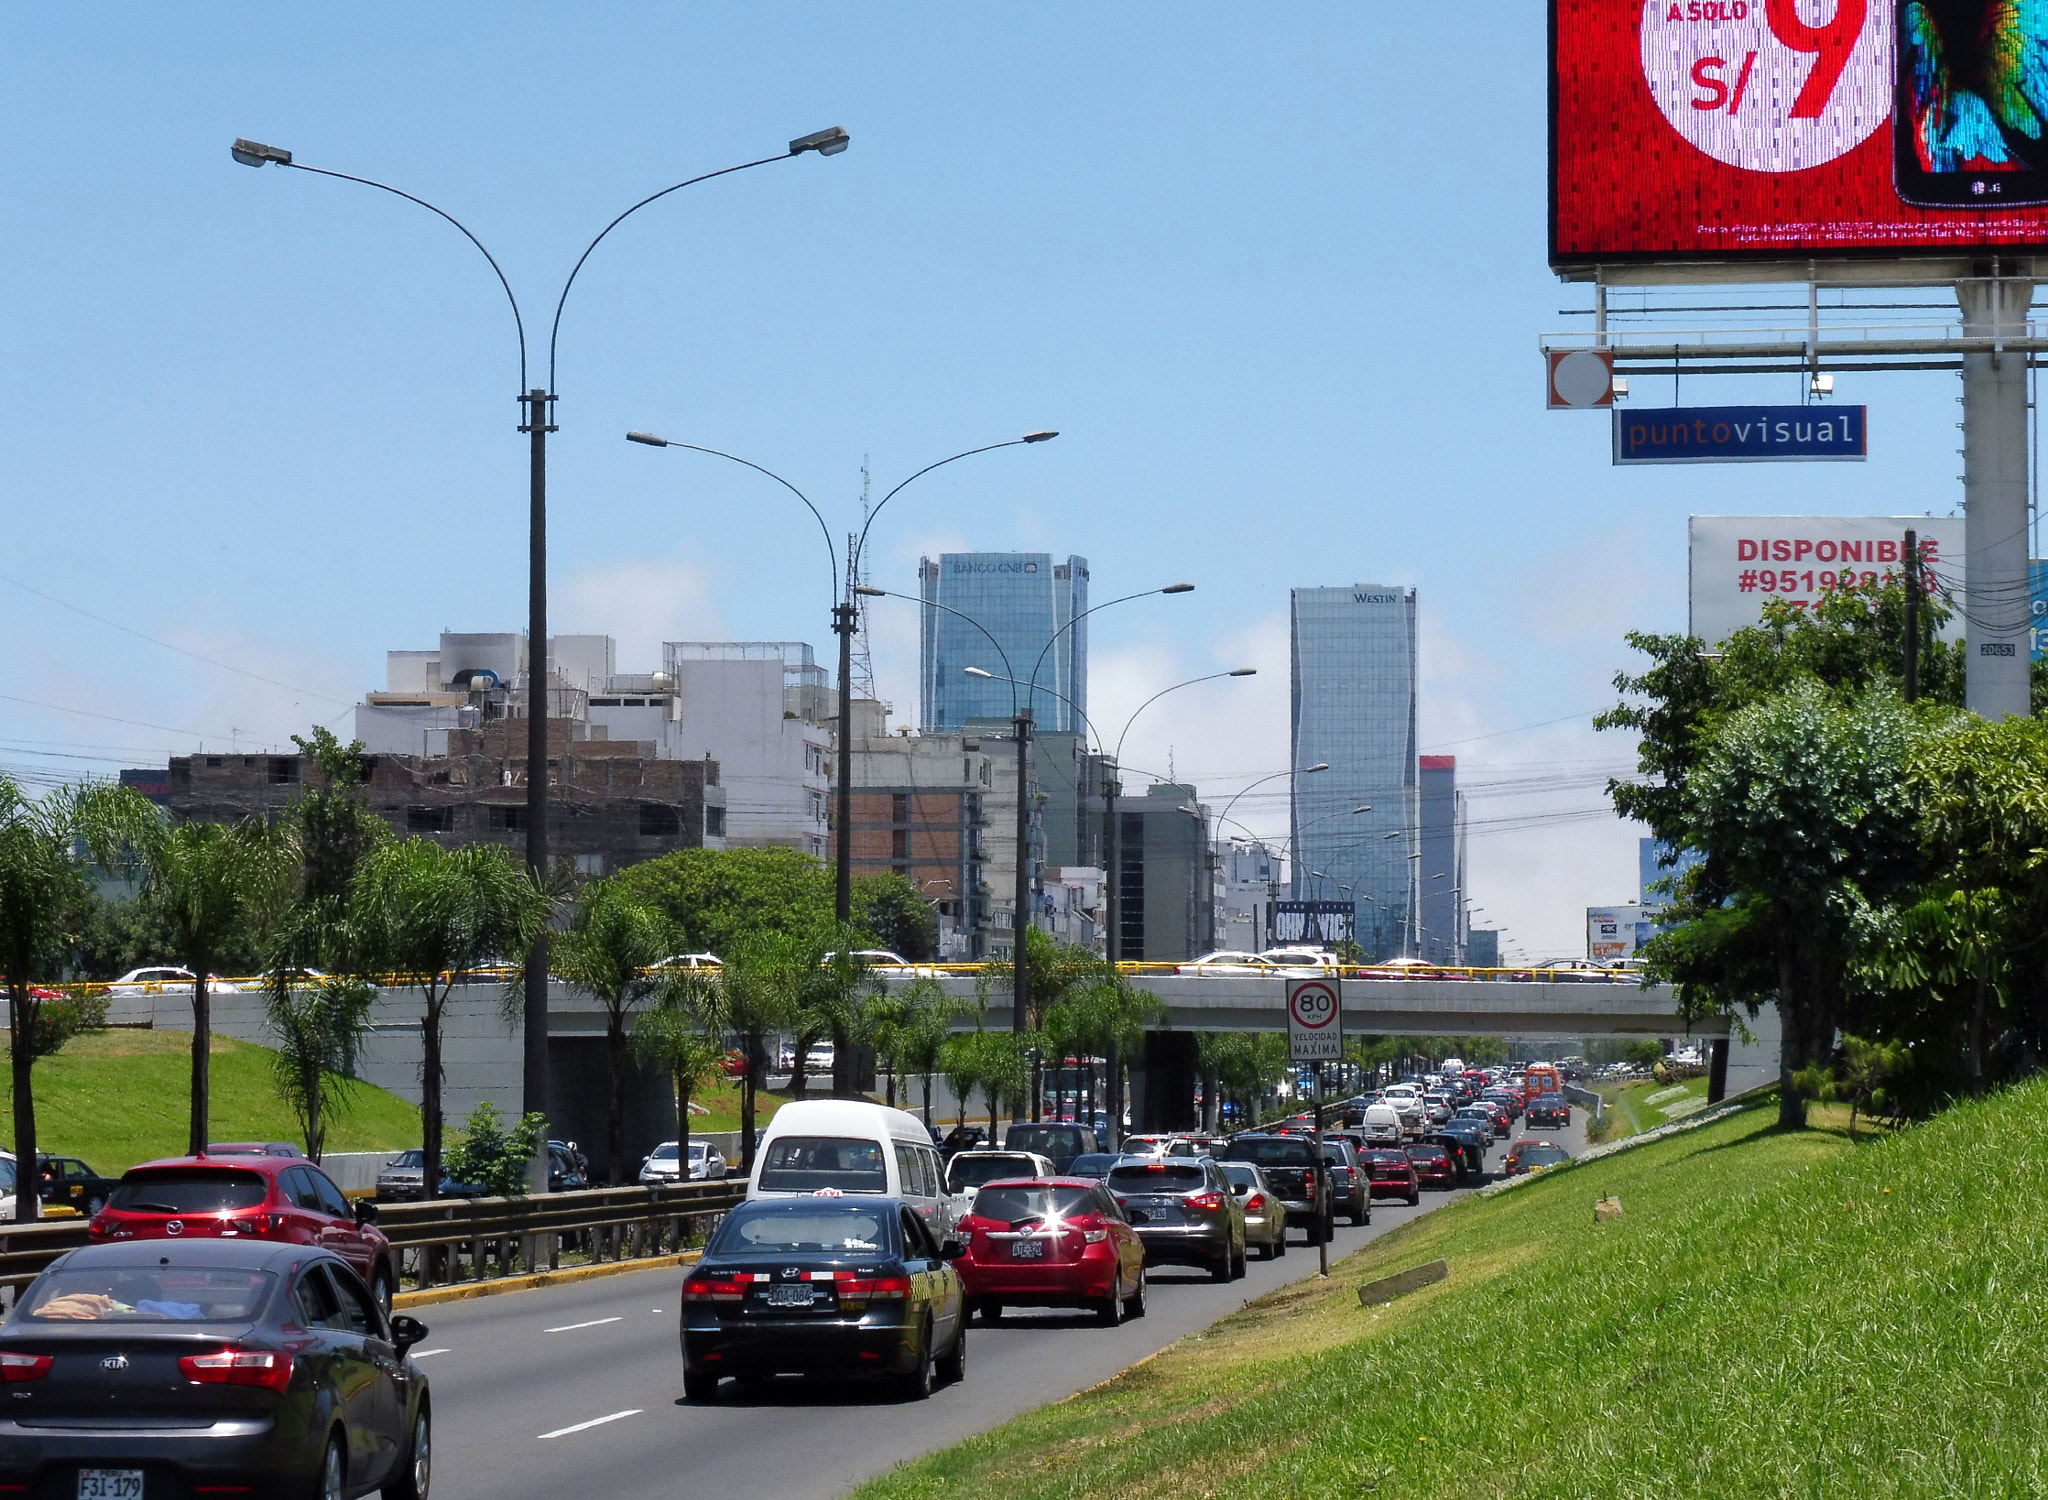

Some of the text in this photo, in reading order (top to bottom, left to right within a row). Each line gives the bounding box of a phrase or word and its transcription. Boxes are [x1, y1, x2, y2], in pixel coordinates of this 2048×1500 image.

[1667, 0, 1748, 22] A SOLO
[1764, 0, 1868, 119] 9
[1690, 51, 1758, 116] S/
[1629, 416, 1854, 451] puntovisual
[953, 563, 996, 574] BANCO
[1982, 645, 2014, 656] 20653
[1300, 994, 1330, 1012] 80
[1294, 1032, 1337, 1041] VELOCIDAD
[1294, 1043, 1338, 1055] MAXIMA
[103, 1360, 125, 1369] KIA
[80, 1477, 141, 1497] F3I-179
